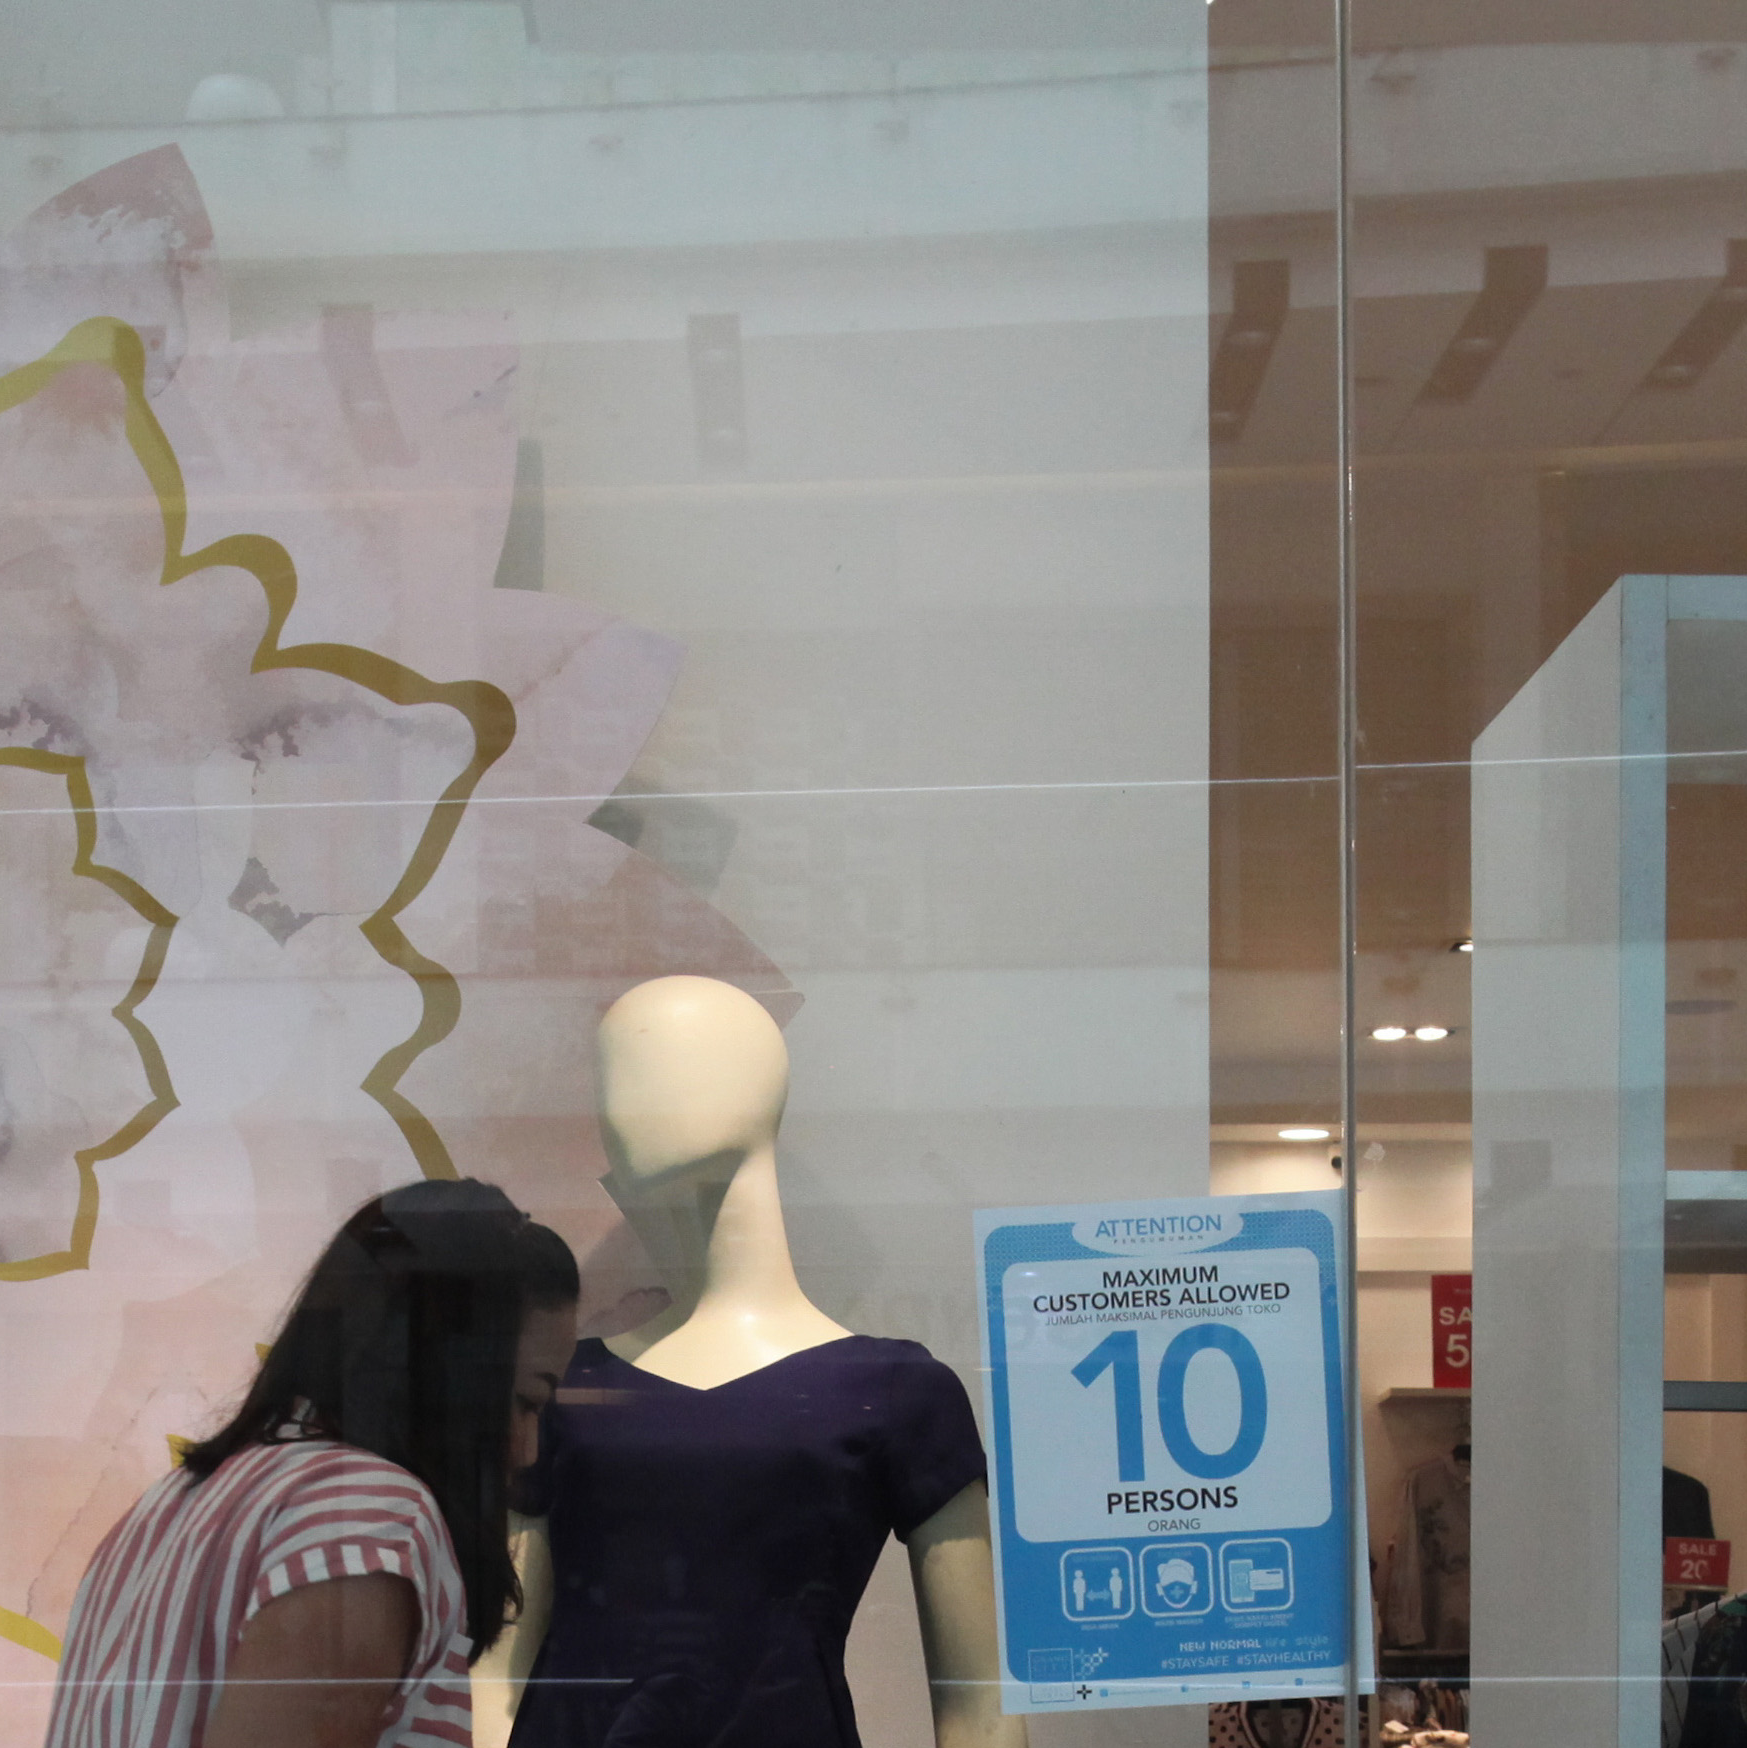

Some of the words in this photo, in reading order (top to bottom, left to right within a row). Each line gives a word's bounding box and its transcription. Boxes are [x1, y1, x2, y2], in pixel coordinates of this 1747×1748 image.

[1095, 1214, 1222, 1238] ATTENTION
[1113, 1235, 1204, 1245] PENGUMUMAN
[1102, 1265, 1219, 1289] MAXIMUM
[1033, 1289, 1172, 1315] CUSTOMERS
[1178, 1281, 1290, 1305] ALLOWED
[1044, 1311, 1094, 1326] JUMLAH
[1096, 1308, 1158, 1323] MAKSIMAL
[1160, 1304, 1244, 1321] PENGUNJUNG
[1246, 1303, 1282, 1315] TOKO
[1070, 1322, 1268, 1482] 10
[1106, 1485, 1239, 1515] PERSONS
[1147, 1517, 1201, 1533] ORANG
[1679, 1542, 1718, 1556] SALE
[1179, 1640, 1207, 1653] NEW
[1209, 1637, 1262, 1652] NORMAL
[1160, 1655, 1230, 1669] #STAYSAFE
[1236, 1650, 1332, 1666] #STAYHEALTHY
